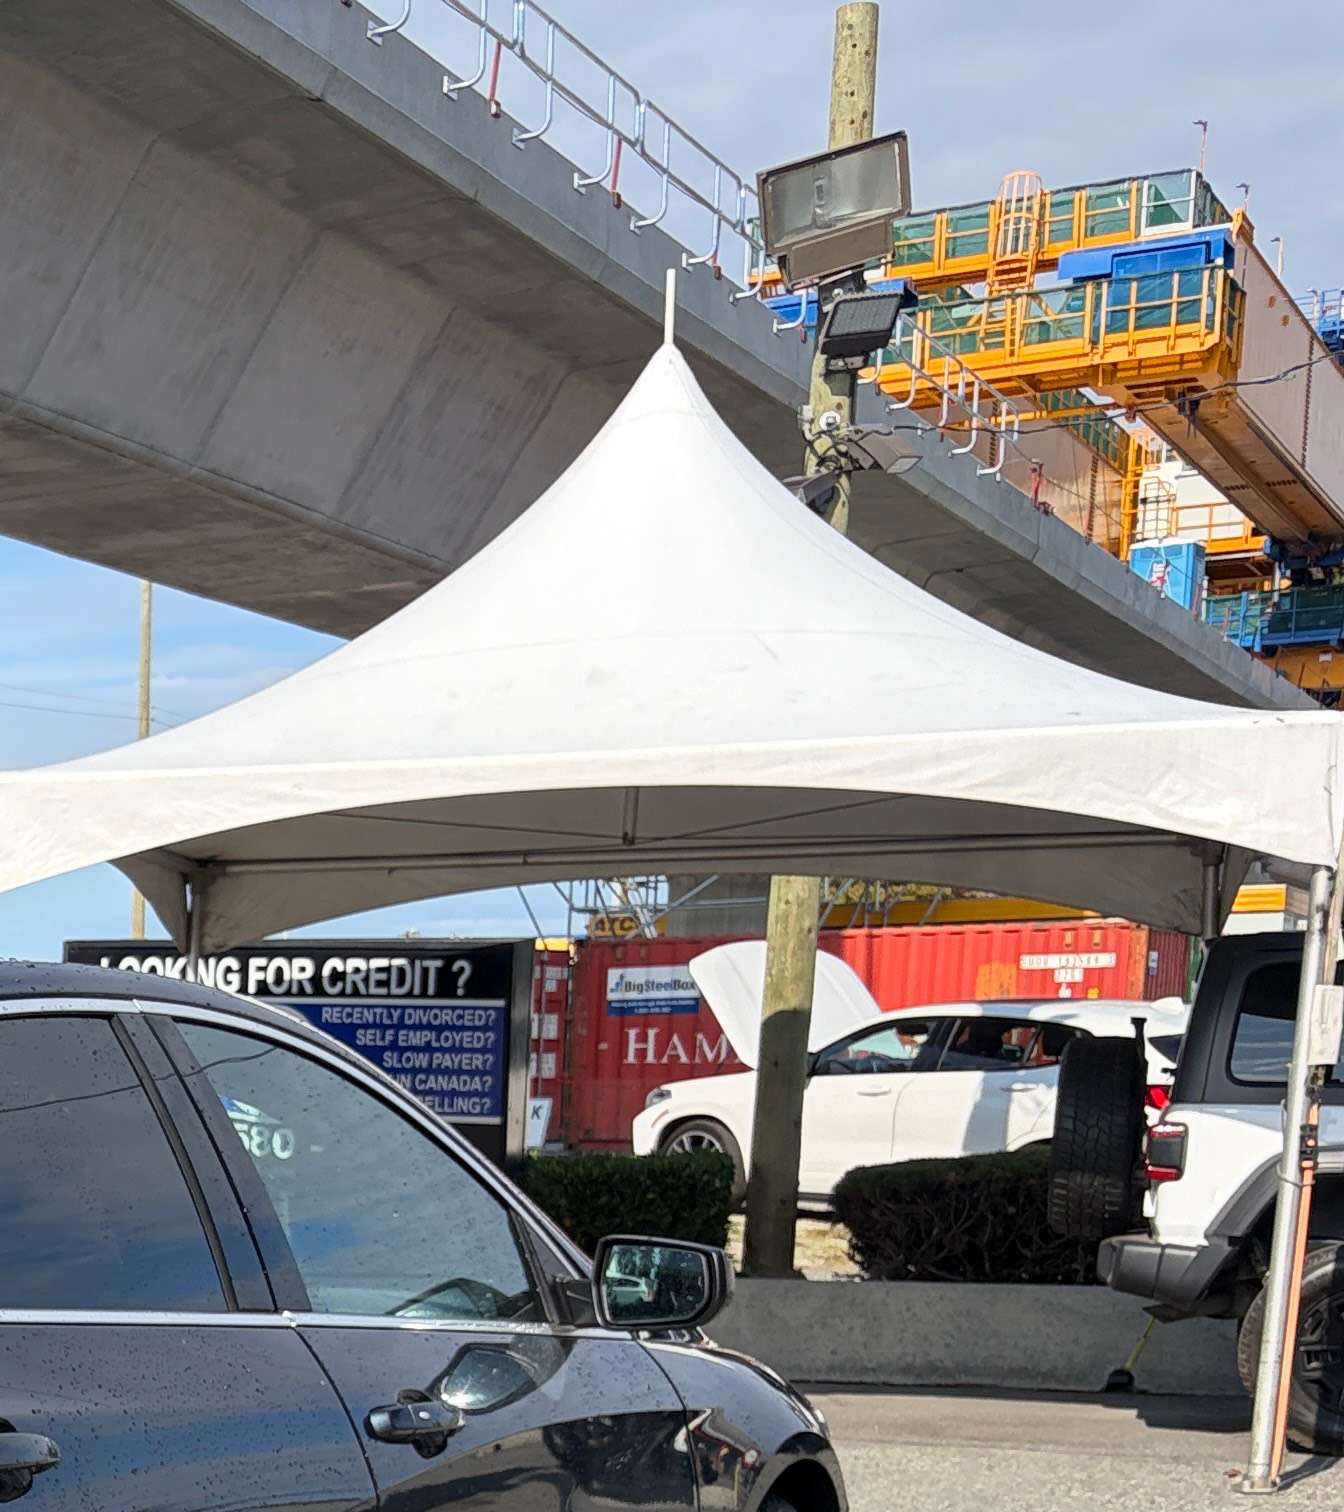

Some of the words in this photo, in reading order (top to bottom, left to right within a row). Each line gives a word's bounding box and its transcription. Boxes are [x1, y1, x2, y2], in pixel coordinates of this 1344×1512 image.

[248, 958, 316, 996] FOR
[322, 959, 444, 996] CREDIT
[452, 960, 475, 997] ?
[624, 979, 696, 995] BigSteelBox
[321, 1007, 401, 1024] RECENTLY
[404, 1008, 496, 1026] DIVORCED?
[355, 1029, 395, 1046] SELF
[398, 1030, 496, 1049] EMPLOYED?
[382, 1051, 429, 1068] SLOW
[432, 1052, 494, 1071] PAYER?
[414, 1074, 493, 1092] CANADA?
